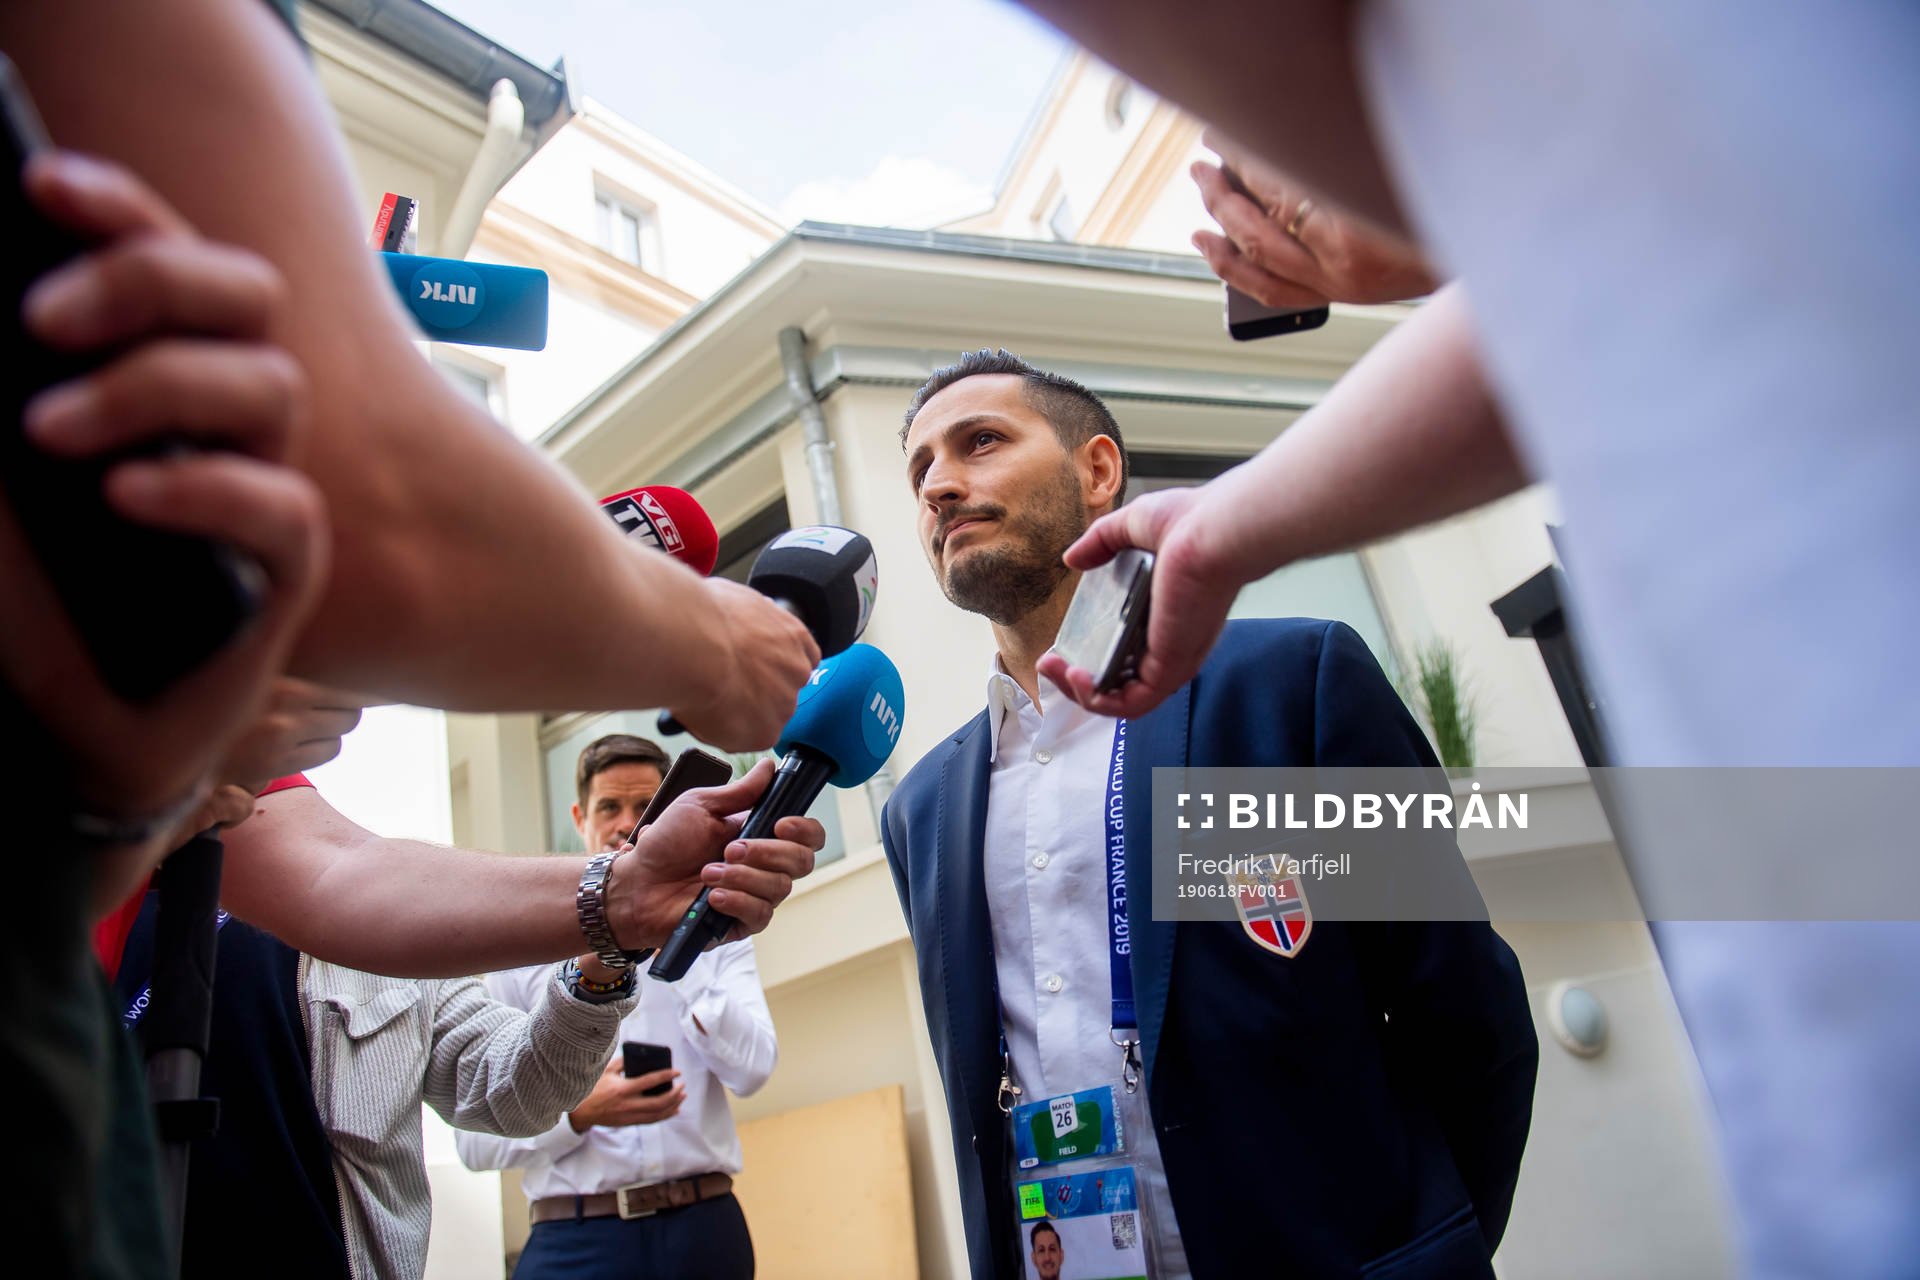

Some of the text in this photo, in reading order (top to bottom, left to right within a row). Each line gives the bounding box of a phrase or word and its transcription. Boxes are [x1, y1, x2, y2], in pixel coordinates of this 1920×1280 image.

[419, 280, 476, 304] NRK
[640, 494, 680, 546] VG
[870, 692, 900, 744] NRK
[1109, 794, 1125, 831] CUP
[1109, 834, 1128, 909] FRANCE
[1113, 912, 1131, 955] 2019
[1051, 1102, 1074, 1111] MATCH
[1055, 1111, 1073, 1129] 26
[1058, 1145, 1078, 1156] FIELD
